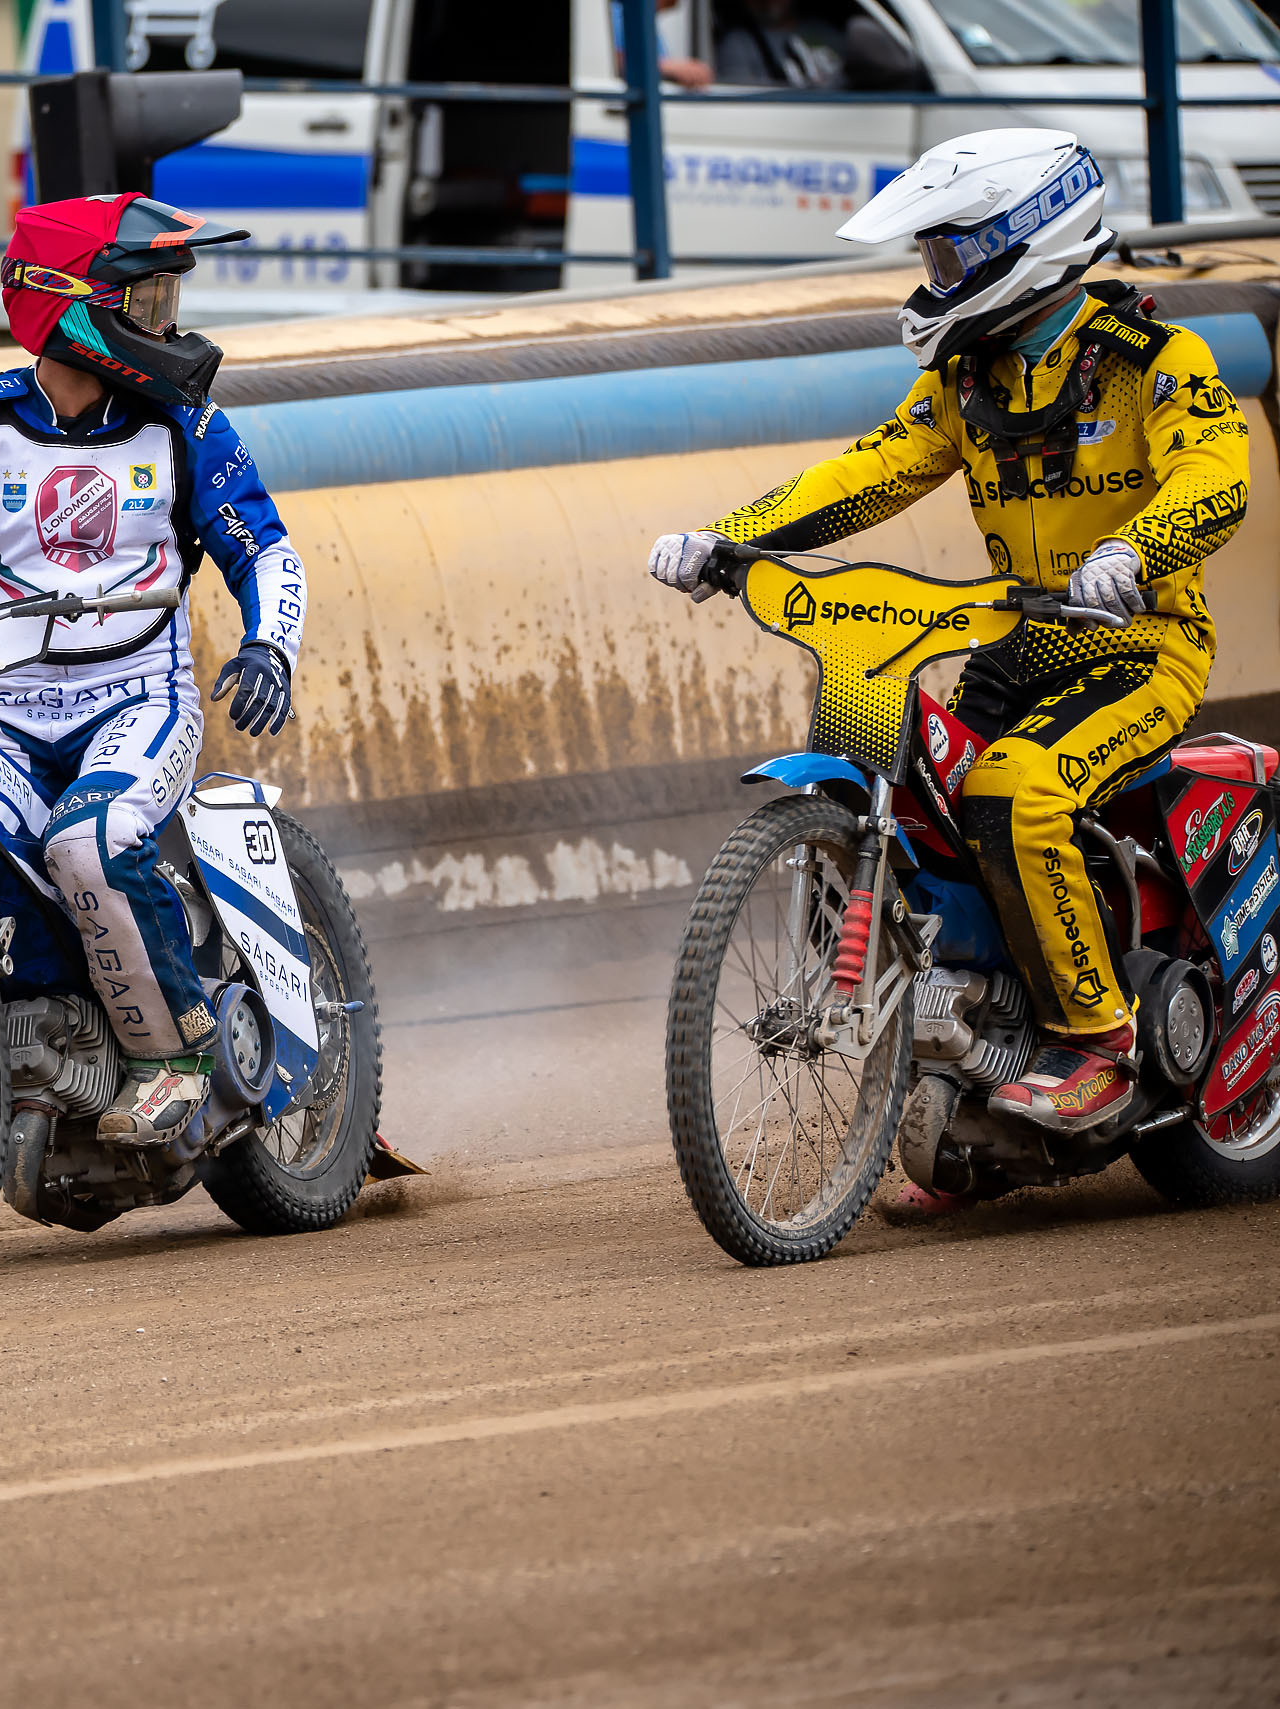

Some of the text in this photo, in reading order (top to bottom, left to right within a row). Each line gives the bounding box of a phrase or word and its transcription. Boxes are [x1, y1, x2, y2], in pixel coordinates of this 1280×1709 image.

[123, 286, 131, 313] OAKLEY
[1114, 325, 1151, 350] MAR
[67, 341, 154, 384] SCOTT
[43, 478, 105, 534] LOKOMOTIV
[820, 600, 970, 631] spechouse
[26, 706, 96, 719] SPORTS
[928, 719, 942, 737] ST
[1220, 791, 1235, 819] A/S
[243, 820, 277, 865] 30
[190, 831, 296, 918] SAGARI SAGARI SAGARI
[1042, 846, 1090, 968] spechouse
[74, 890, 151, 1037] SAGARI
[240, 931, 307, 1002] SAGARI
[259, 970, 290, 1000] SPORTS
[1222, 1043, 1248, 1080] DANO
